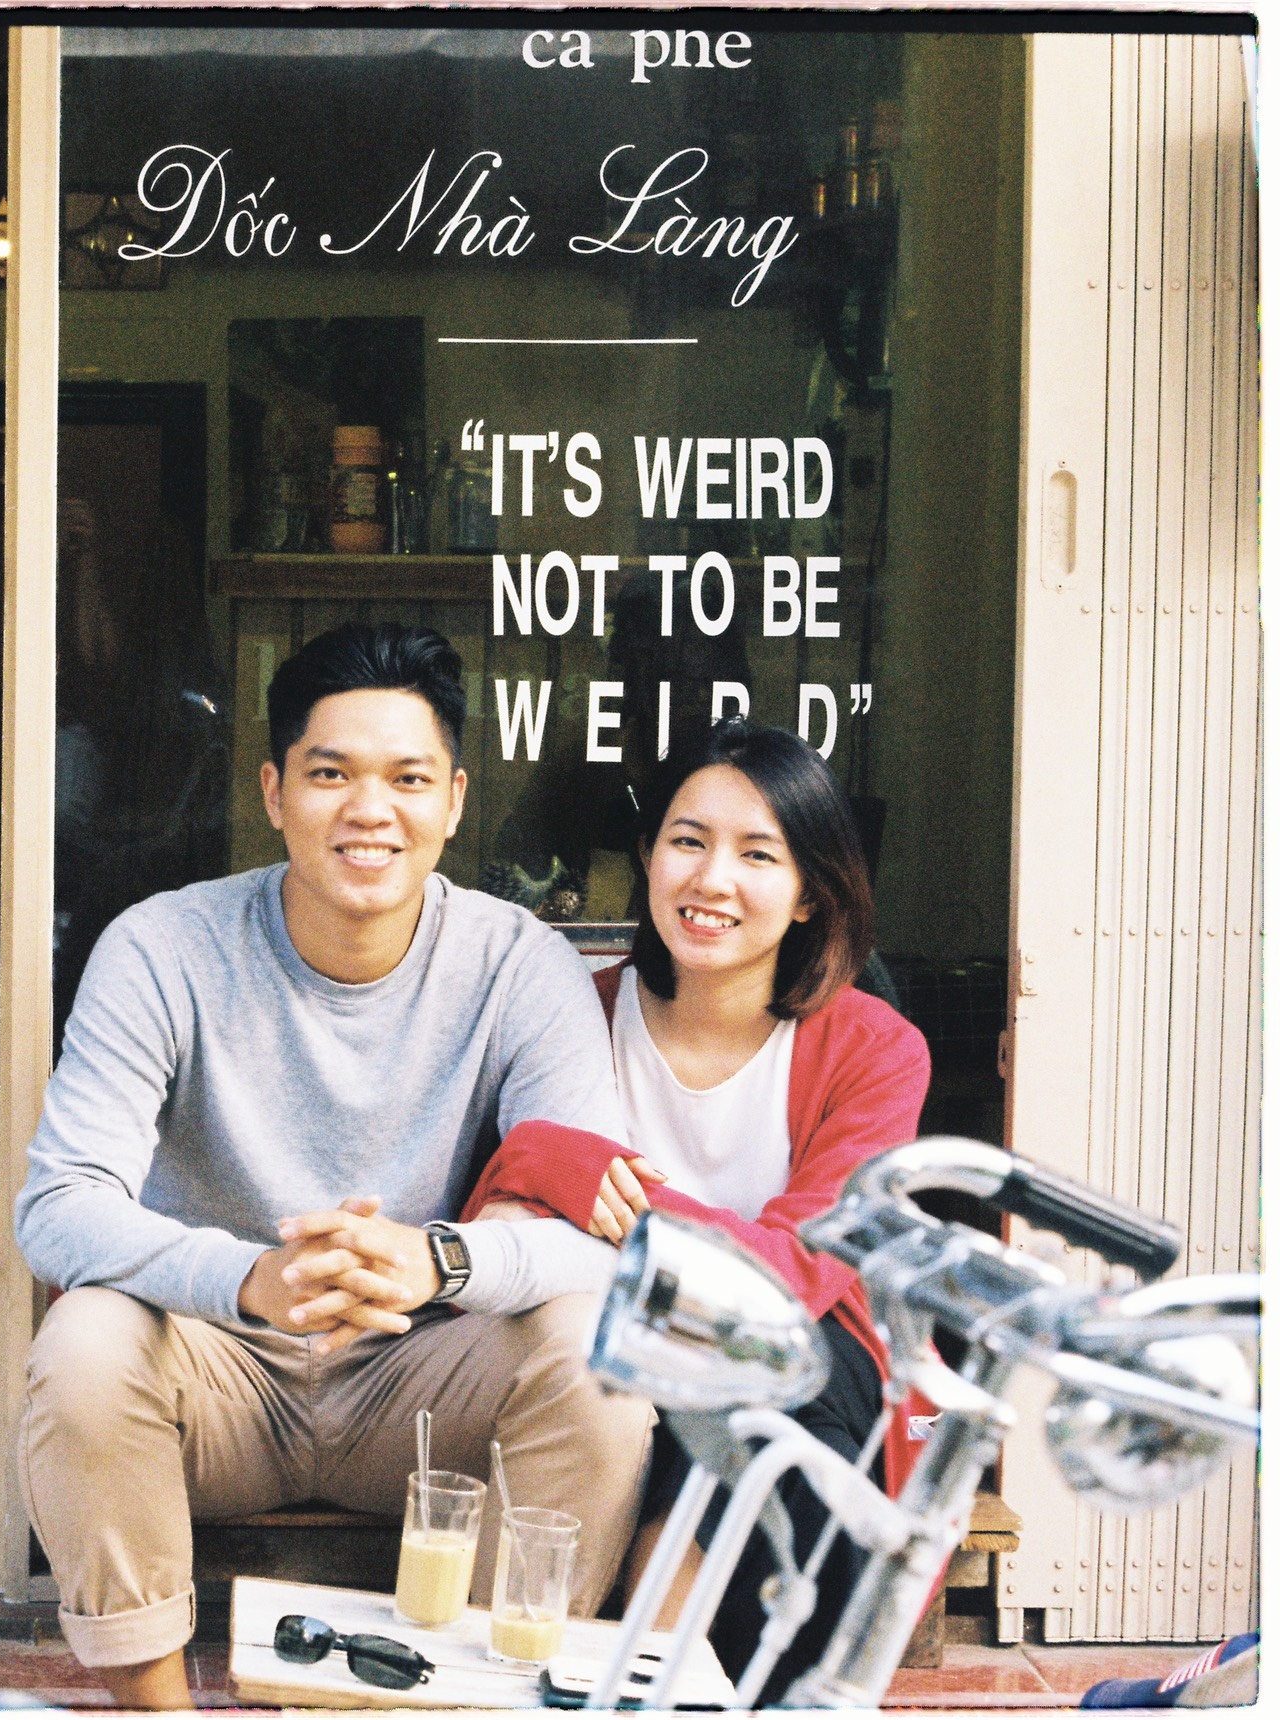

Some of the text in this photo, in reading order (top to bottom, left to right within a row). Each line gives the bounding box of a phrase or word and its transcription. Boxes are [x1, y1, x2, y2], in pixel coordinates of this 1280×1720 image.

[118, 144, 799, 308] Dốc Nhà Làng
[461, 419, 834, 520] “IT’S WEIRD
[493, 550, 841, 638] NOT TO BE
